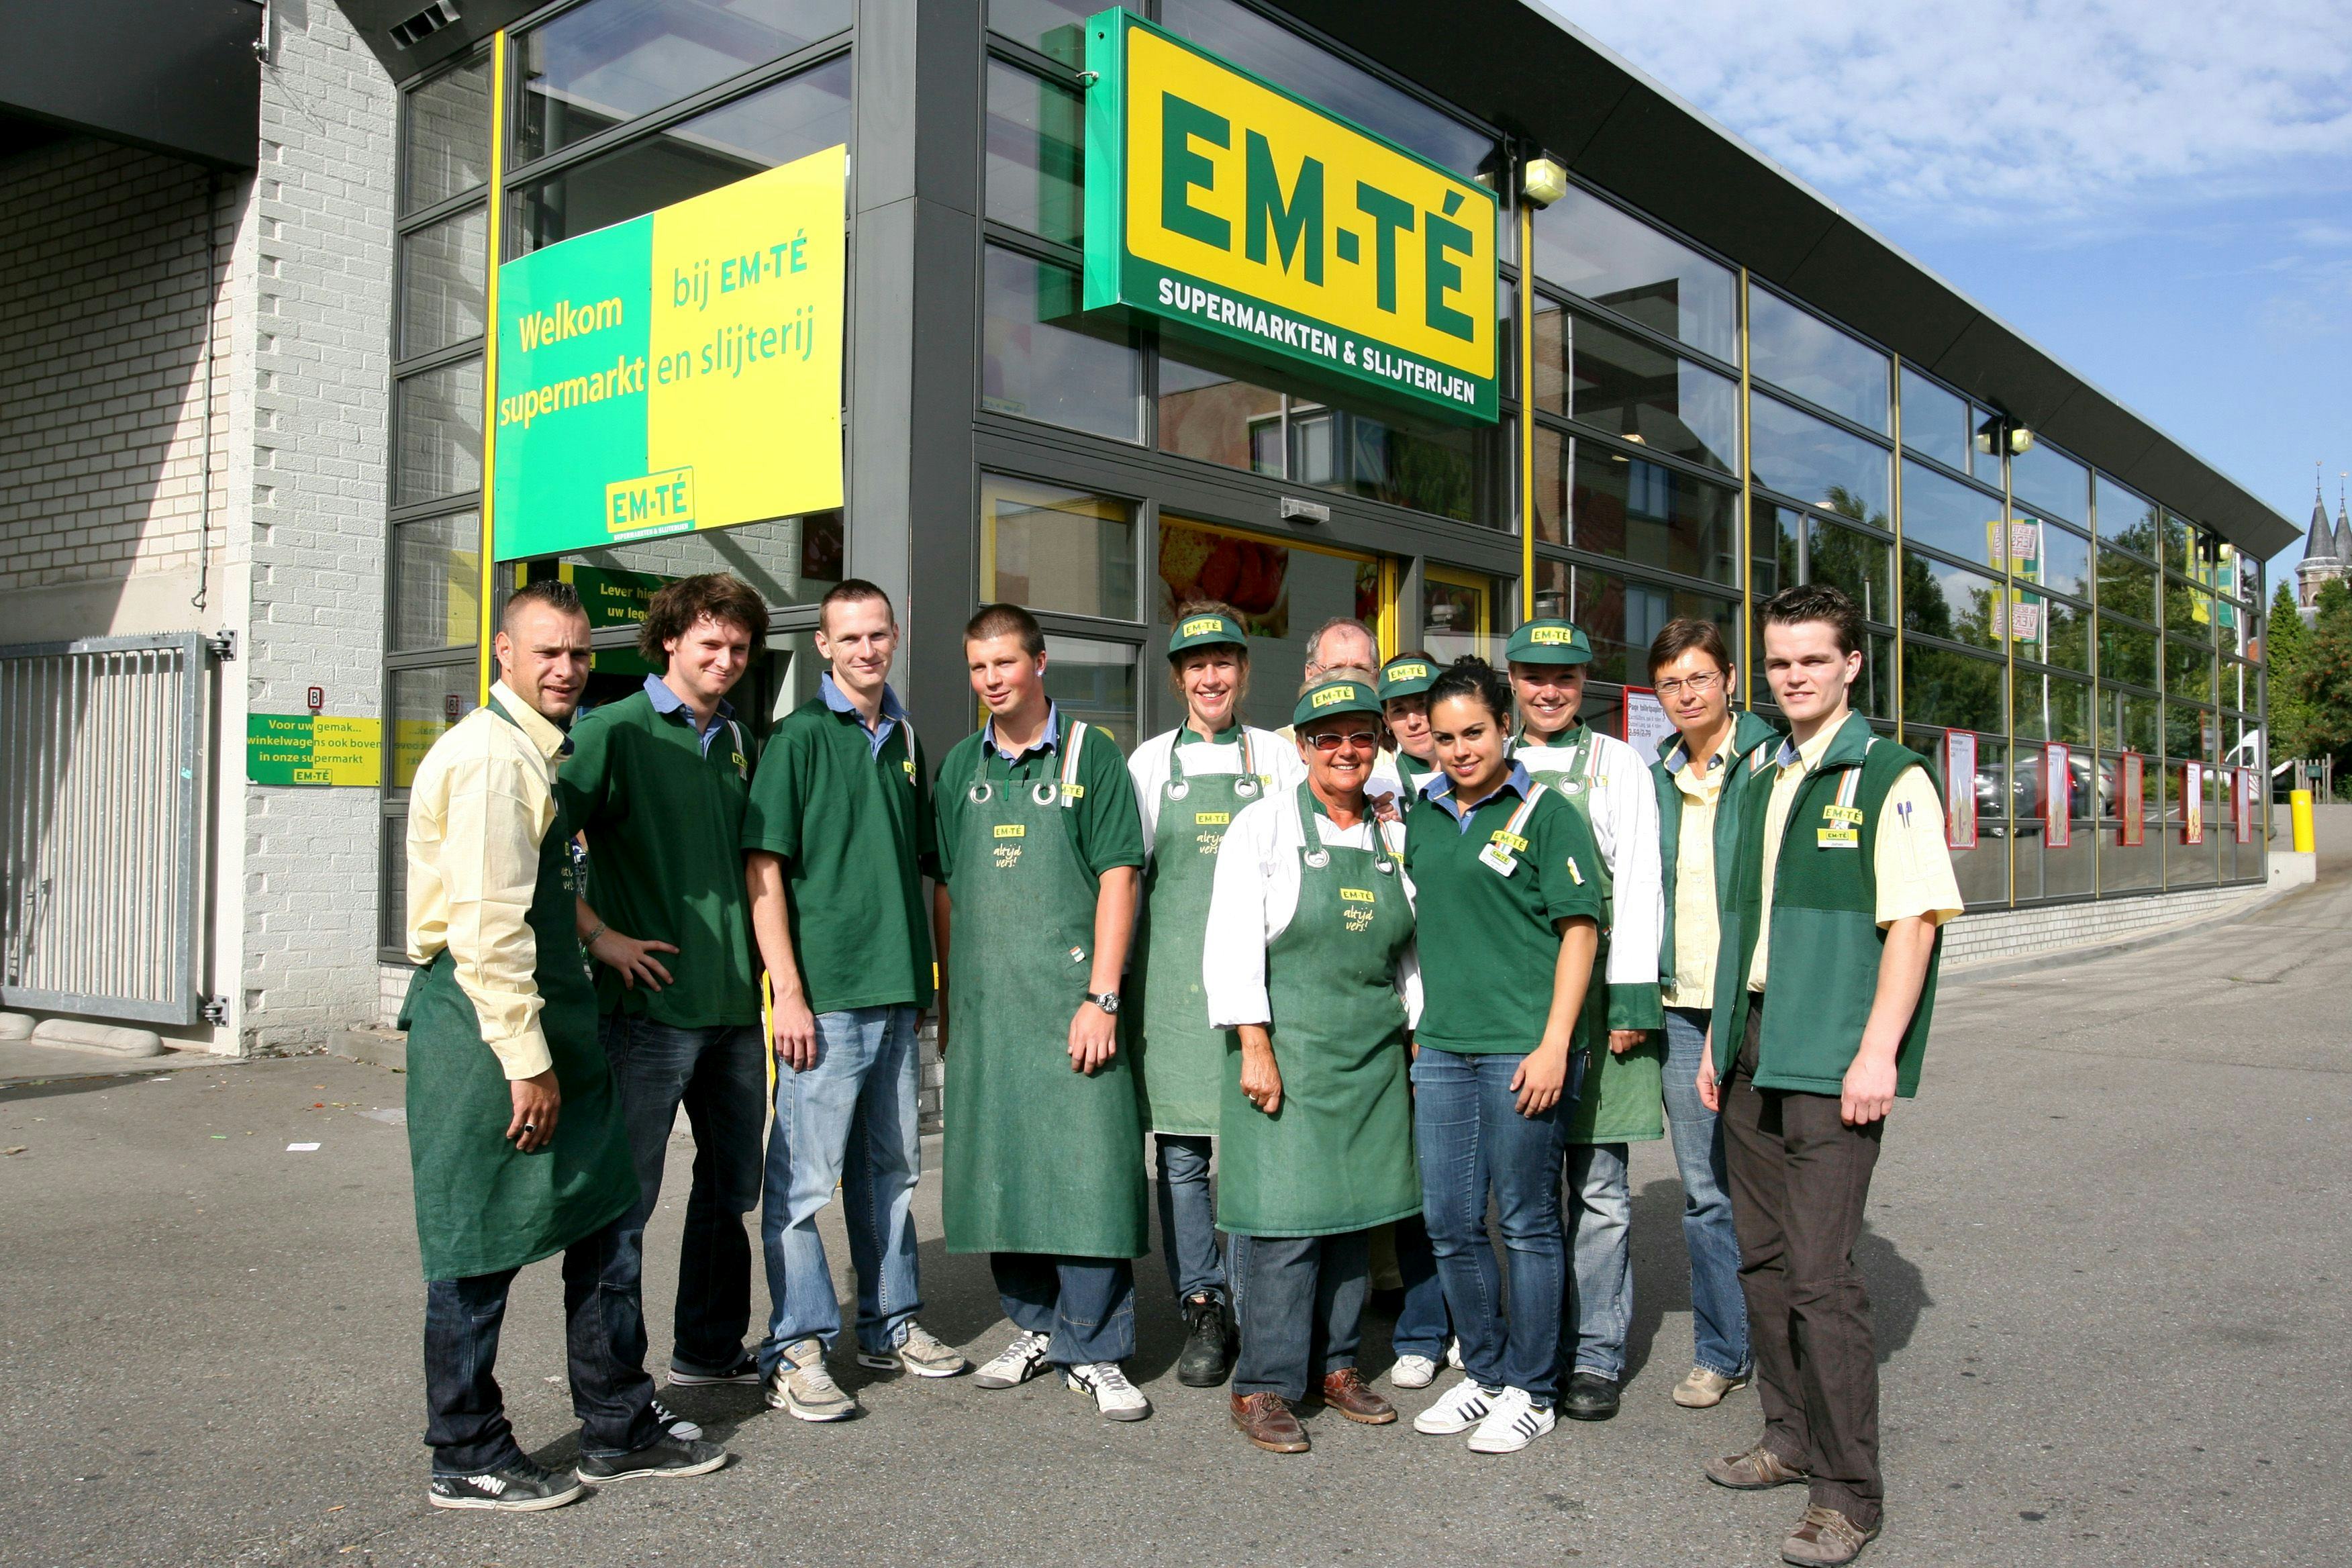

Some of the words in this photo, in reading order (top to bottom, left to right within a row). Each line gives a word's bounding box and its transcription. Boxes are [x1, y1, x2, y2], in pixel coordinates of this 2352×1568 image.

[1161, 90, 1474, 344] EM-TÉ
[519, 297, 622, 353] Welkom
[674, 258, 709, 312] bij
[721, 228, 807, 293] EM-TÉ
[1159, 277, 1337, 360] SUPERMARKTEN
[1342, 340, 1357, 366] &
[1362, 347, 1475, 405] SLIJTERIJEN
[500, 354, 645, 430] supermarkt
[657, 350, 691, 385] en
[701, 305, 814, 379] slijterij
[613, 474, 687, 524] EM-TÉ
[600, 583, 633, 597] Lever
[607, 607, 624, 617] uw
[312, 691, 318, 704] B
[268, 720, 295, 730] Voor
[317, 722, 362, 733] gemak...
[247, 735, 326, 749] winkelwagens
[328, 738, 348, 747] ook
[350, 738, 381, 748] boven
[259, 752, 270, 761] in
[273, 754, 299, 763] onze
[301, 754, 363, 765] supermarkt
[297, 770, 329, 780] EM-TÉ
[993, 843, 1022, 860] altijd
[996, 856, 1017, 868] vers!
[1344, 905, 1373, 924] altijd
[1346, 921, 1368, 932] vers!
